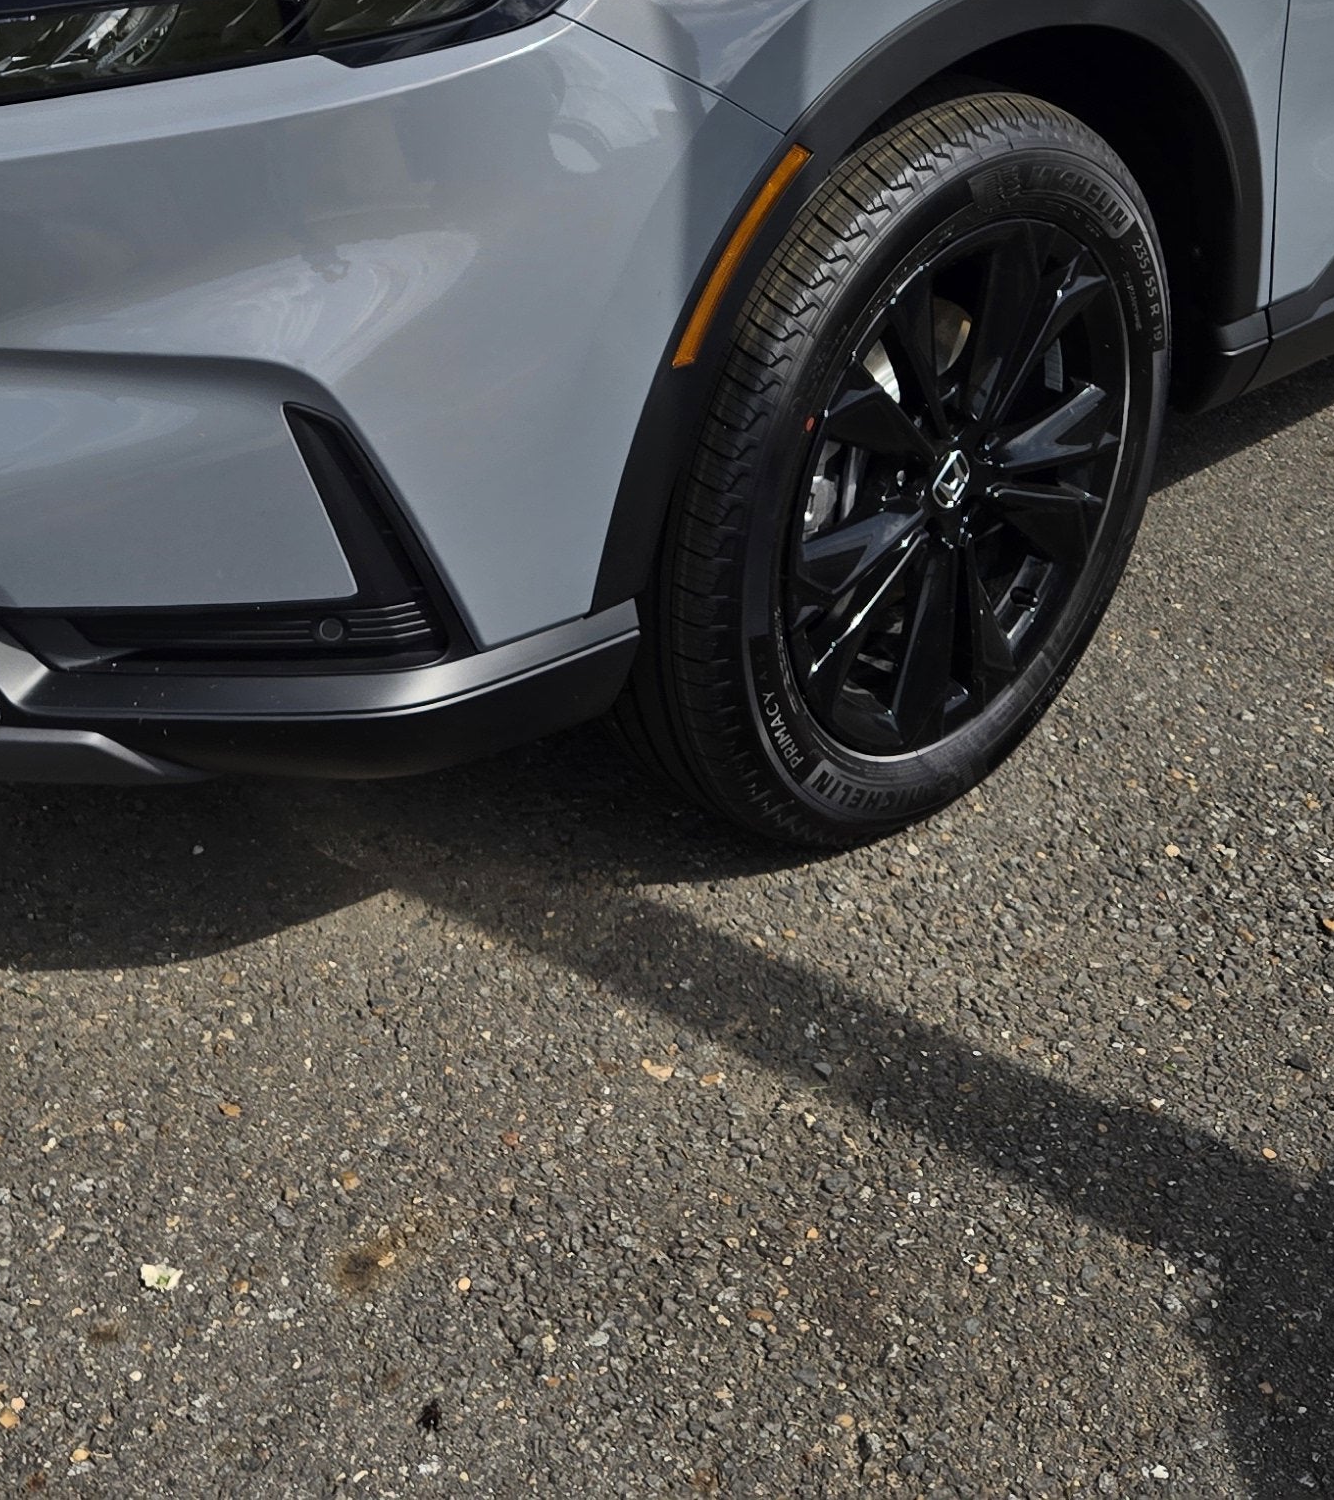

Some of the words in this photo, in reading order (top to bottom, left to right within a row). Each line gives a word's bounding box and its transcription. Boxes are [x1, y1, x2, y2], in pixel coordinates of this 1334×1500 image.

[1029, 166, 1129, 231] MICHELIN
[1132, 239, 1158, 298] 235/55
[1149, 302, 1161, 317] R
[1152, 323, 1164, 342] 19
[762, 690, 805, 770] PRIMACY
[811, 771, 929, 809] MICHELIN
